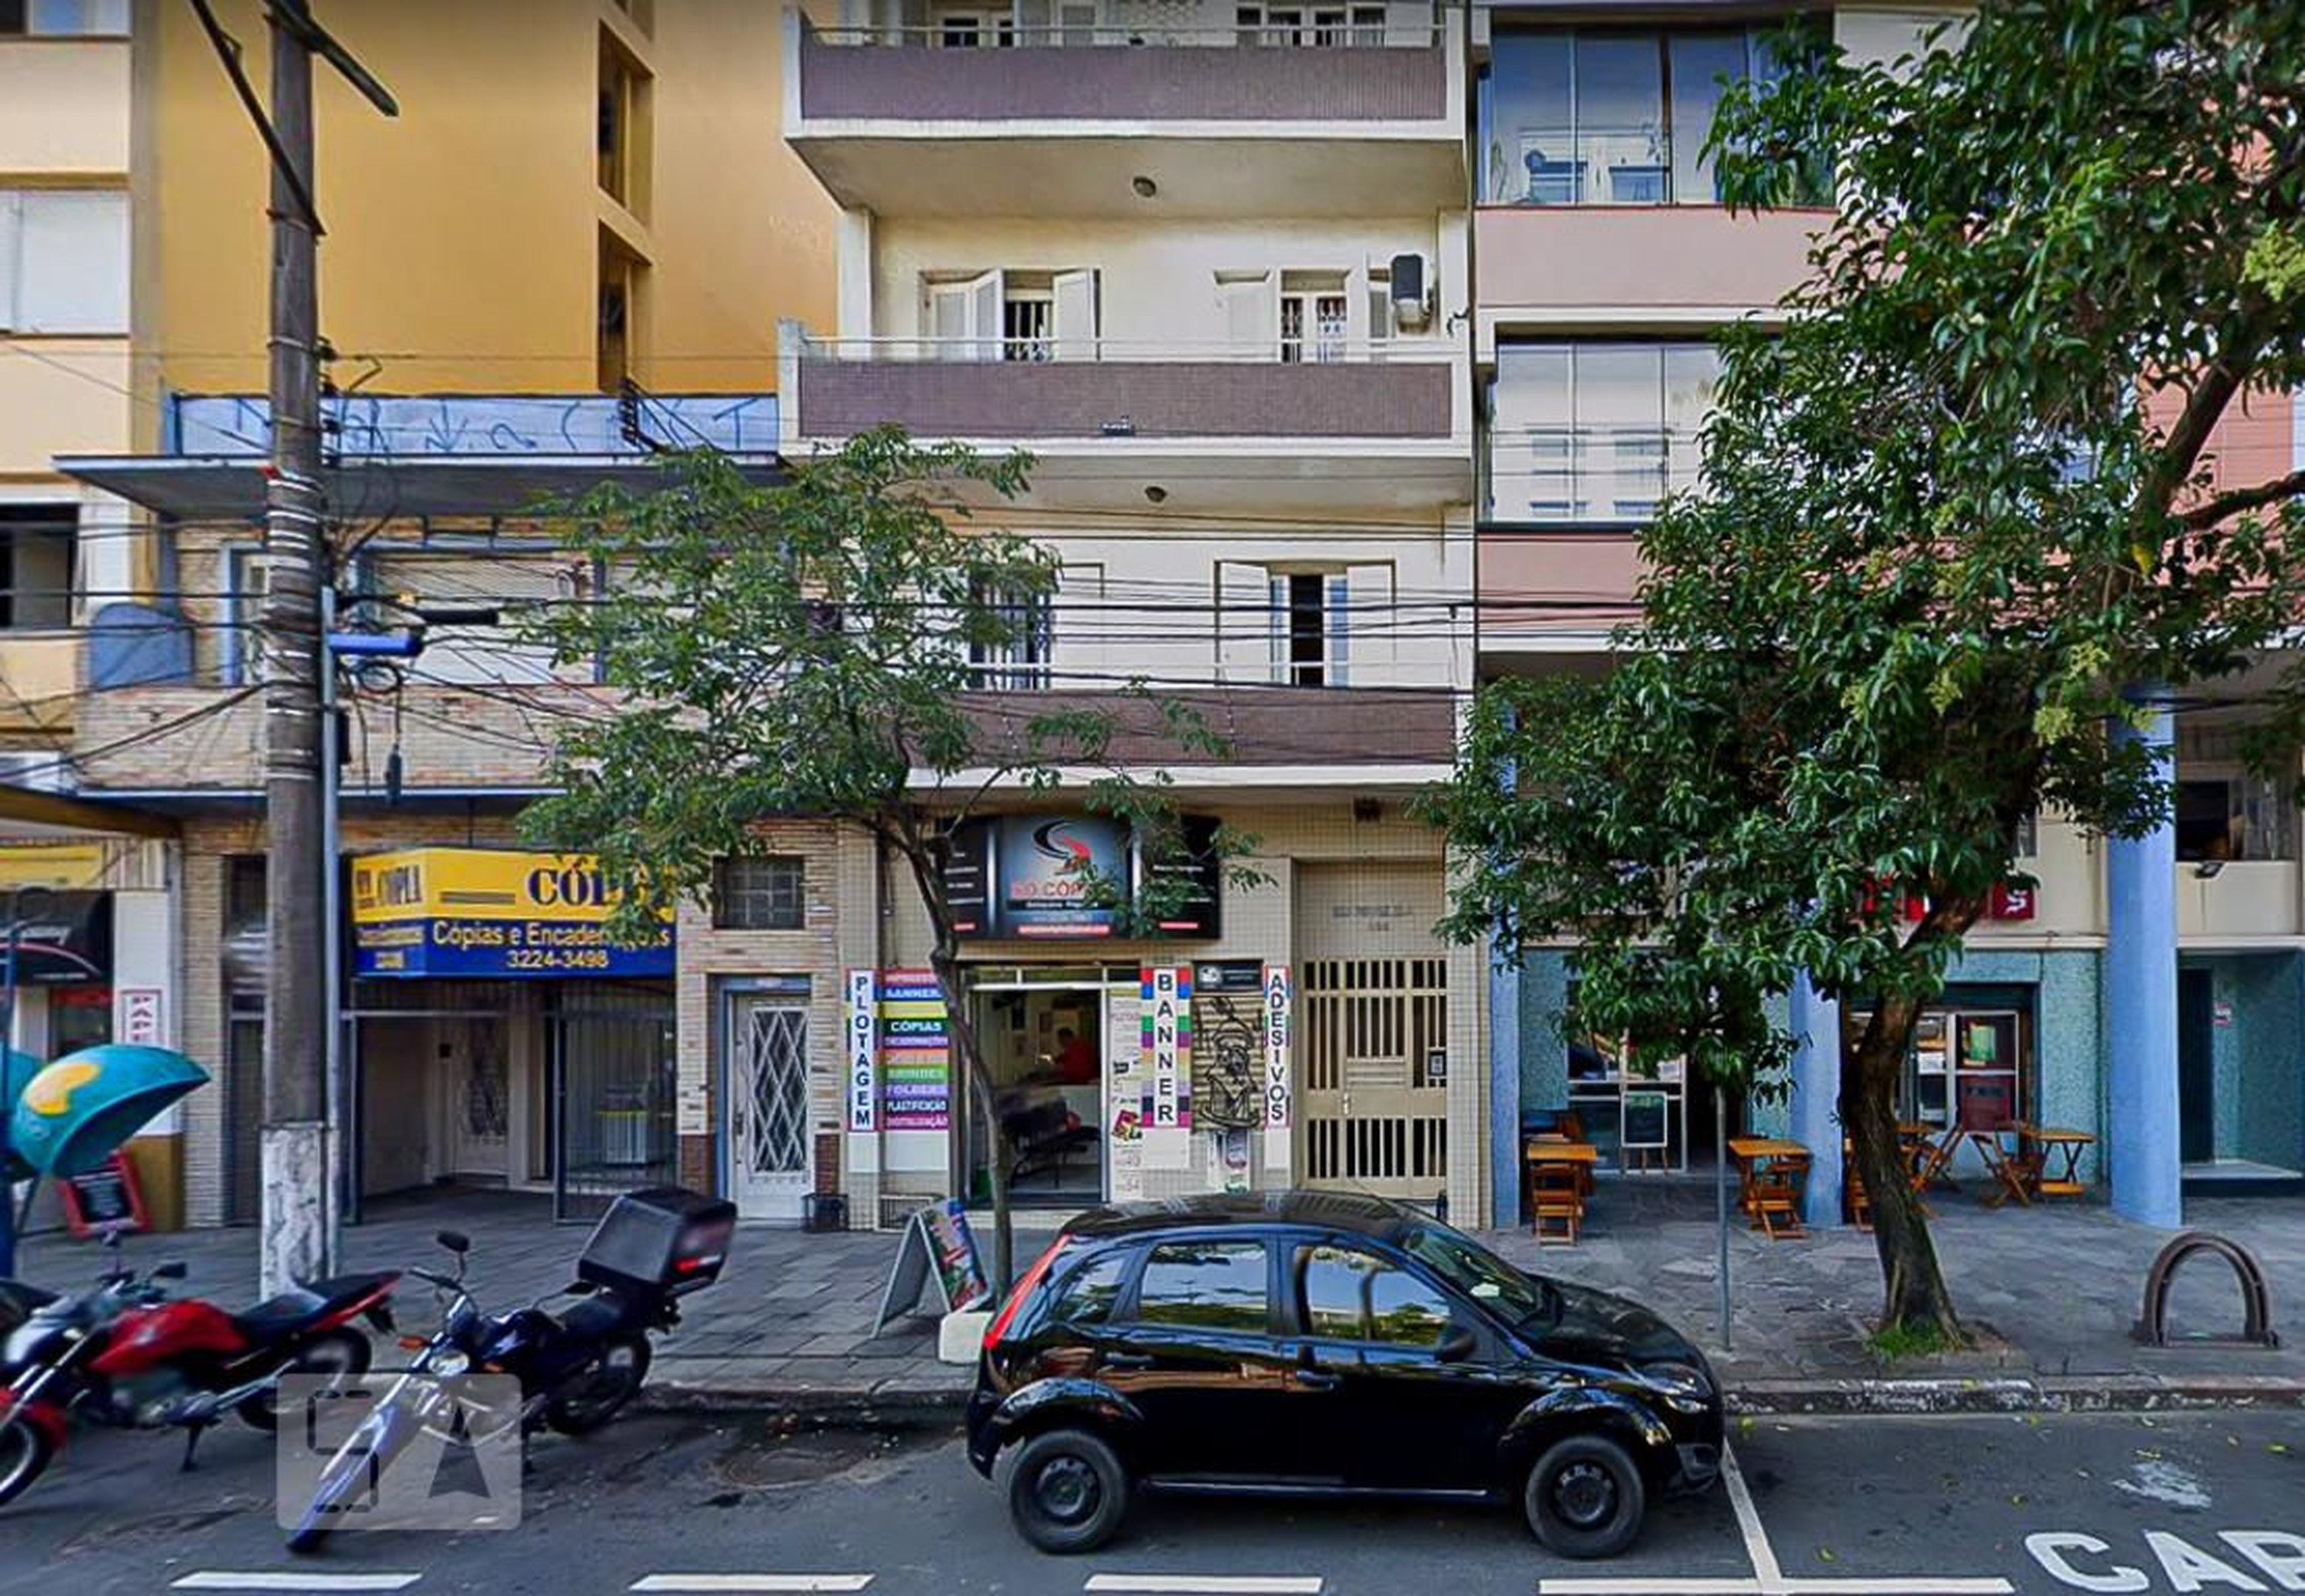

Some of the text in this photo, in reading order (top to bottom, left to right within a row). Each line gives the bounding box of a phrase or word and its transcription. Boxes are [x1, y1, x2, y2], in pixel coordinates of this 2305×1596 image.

[433, 920, 504, 951] Cópias
[511, 927, 522, 945] e
[507, 950, 609, 969] 3224-3498
[855, 976, 870, 1126] PLOTAGEM
[1158, 974, 1174, 1122] BANNER
[1269, 974, 1285, 1121] ADESIVOS
